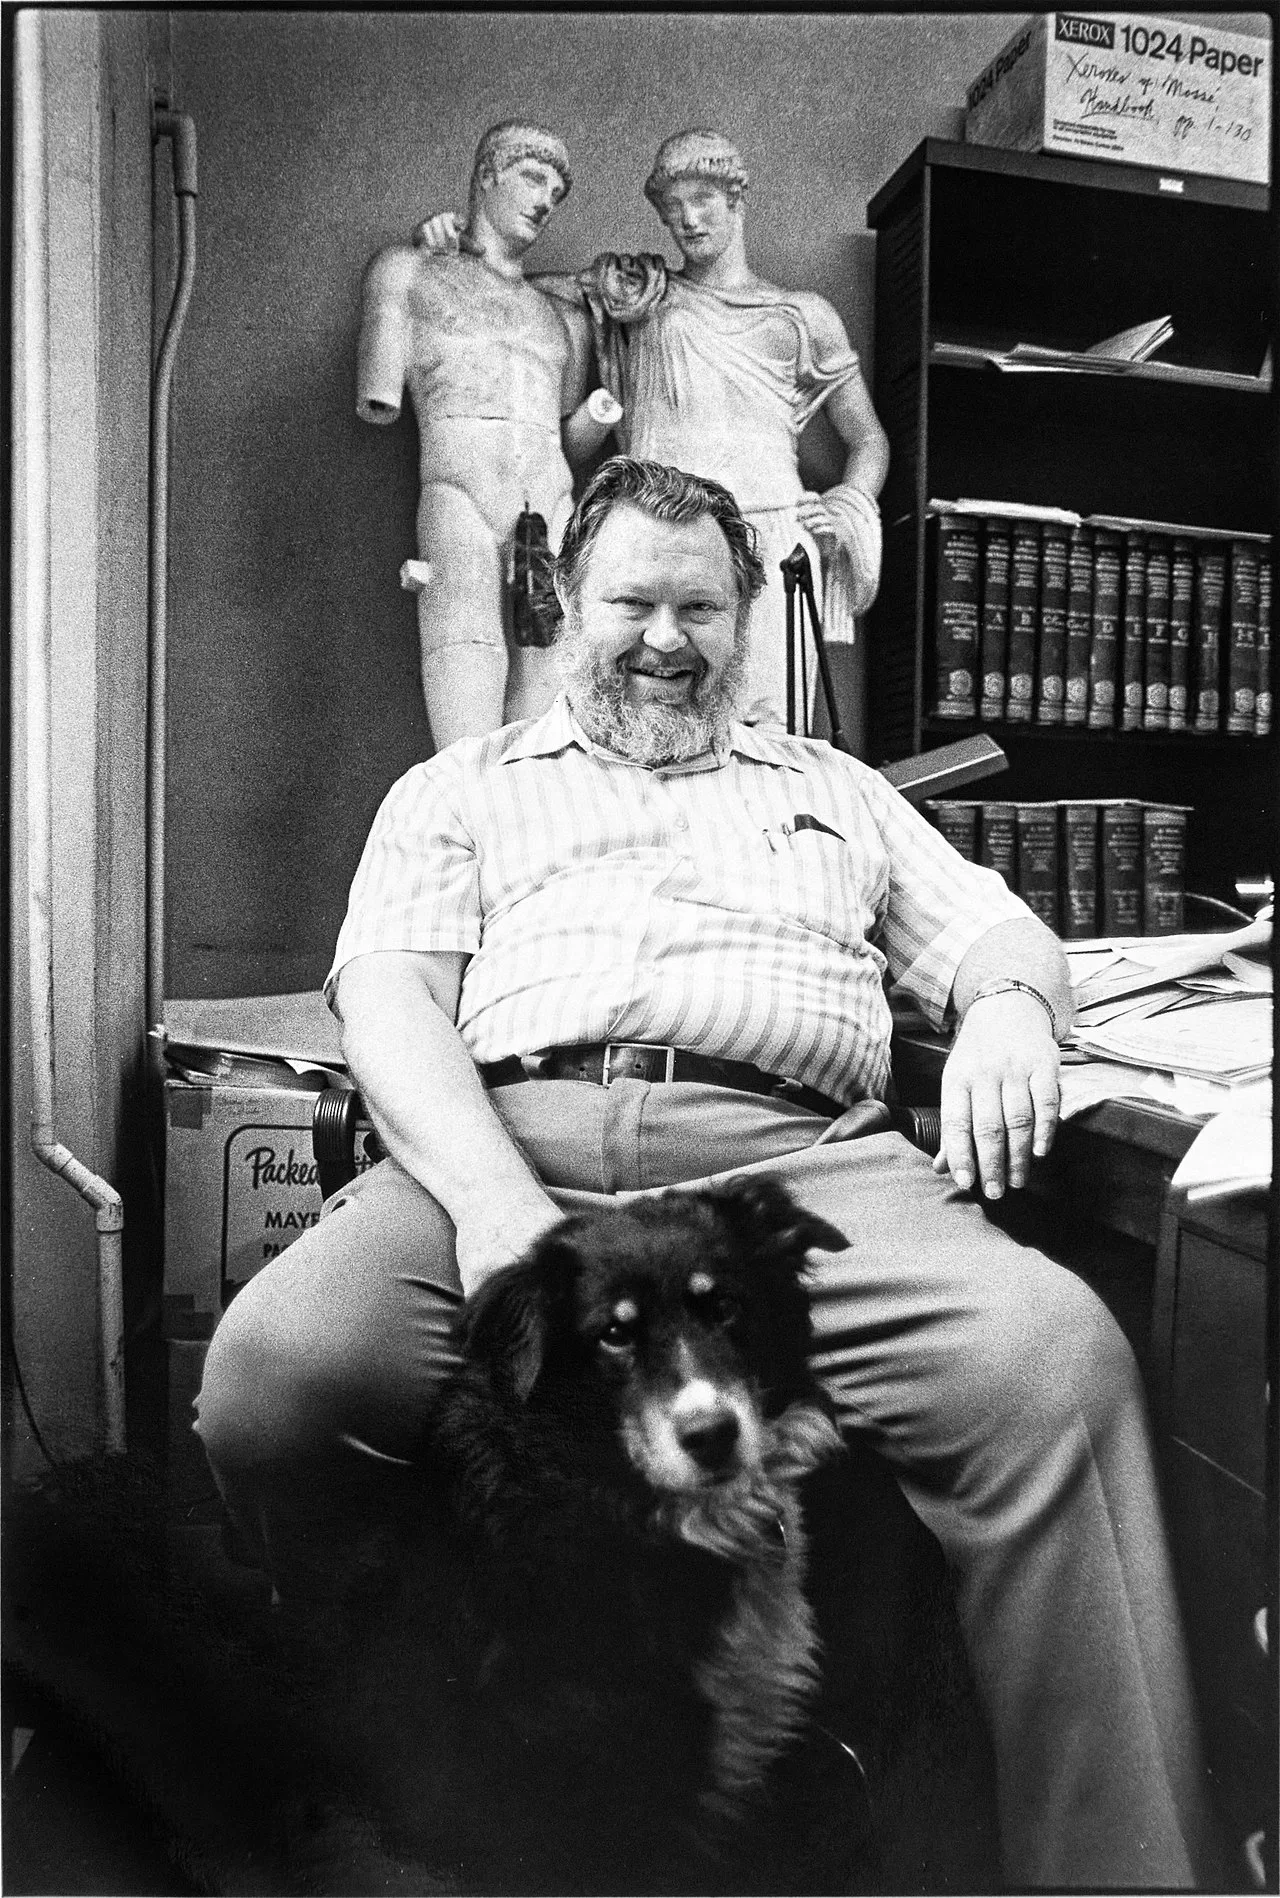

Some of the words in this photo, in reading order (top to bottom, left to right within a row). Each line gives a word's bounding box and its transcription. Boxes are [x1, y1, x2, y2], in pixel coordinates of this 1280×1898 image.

[1058, 18, 1112, 45] XEROX
[1120, 24, 1183, 63] 1024
[1188, 35, 1265, 78] Paper
